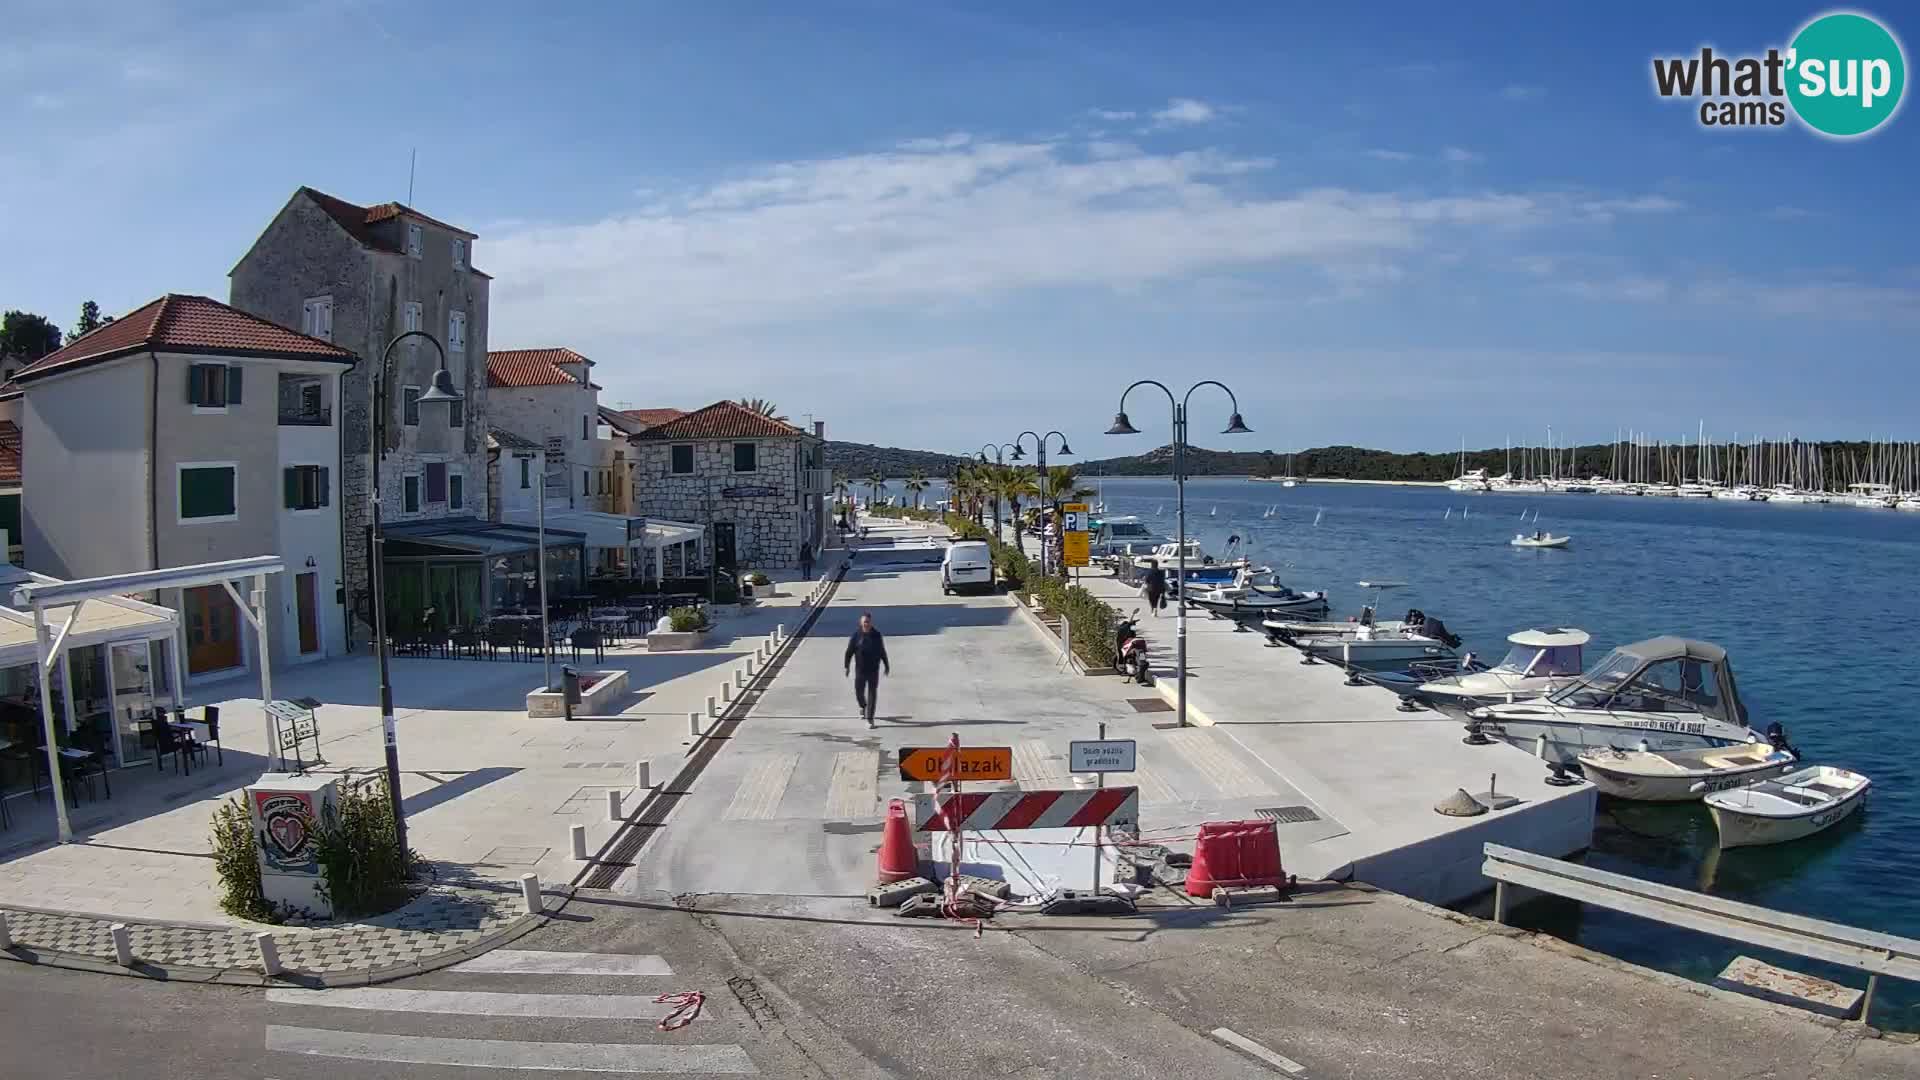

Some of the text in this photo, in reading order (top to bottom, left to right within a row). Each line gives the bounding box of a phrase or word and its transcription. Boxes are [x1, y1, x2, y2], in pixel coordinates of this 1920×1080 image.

[1660, 721, 1679, 731] RENT
[1680, 722, 1686, 731] A
[1686, 723, 1706, 734] BOAT
[925, 756, 1002, 773] Olazak
